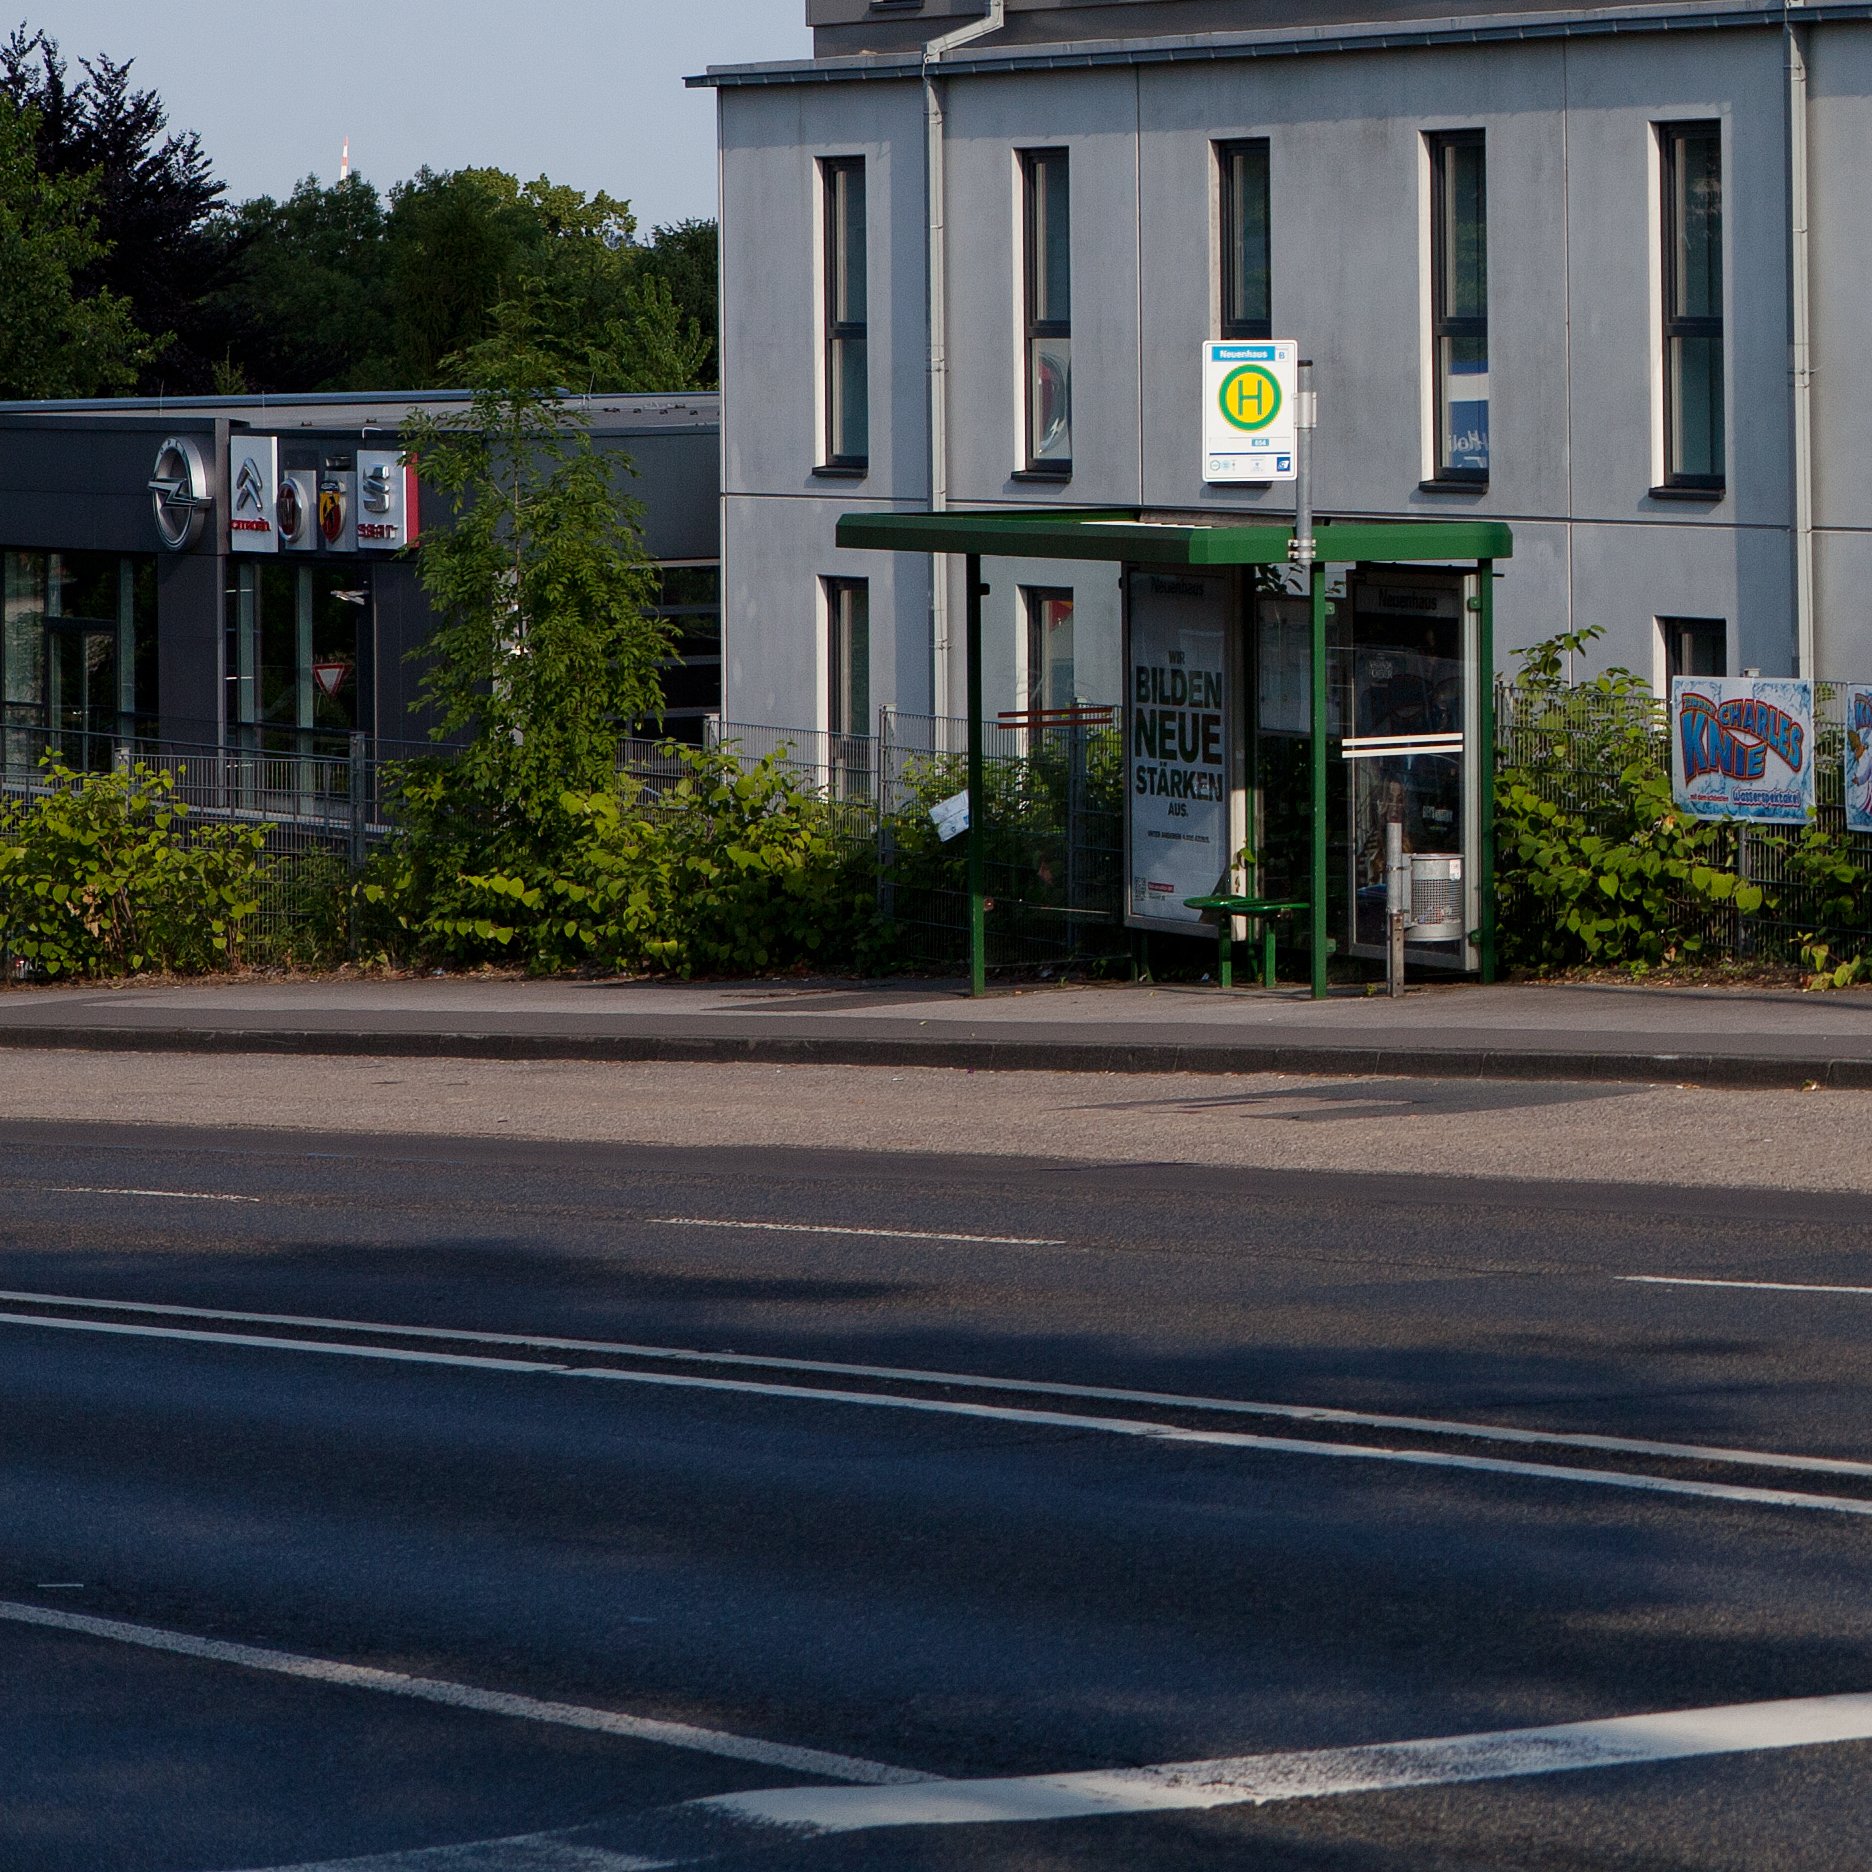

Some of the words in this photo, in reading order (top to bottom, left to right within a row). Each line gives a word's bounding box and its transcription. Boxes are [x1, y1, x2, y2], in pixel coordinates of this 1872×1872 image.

[1219, 349, 1268, 359] Neuenhaus
[1237, 379, 1263, 416] H
[1378, 588, 1438, 611] Neuenhaus
[1168, 650, 1185, 665] WIR
[1135, 666, 1222, 710] BILDEN
[1135, 708, 1222, 765] NEUE
[1680, 708, 1768, 787] KNIE
[1718, 698, 1804, 773] CHARLES
[1135, 762, 1223, 802] STÄRKEN
[1167, 802, 1189, 818] AUS.
